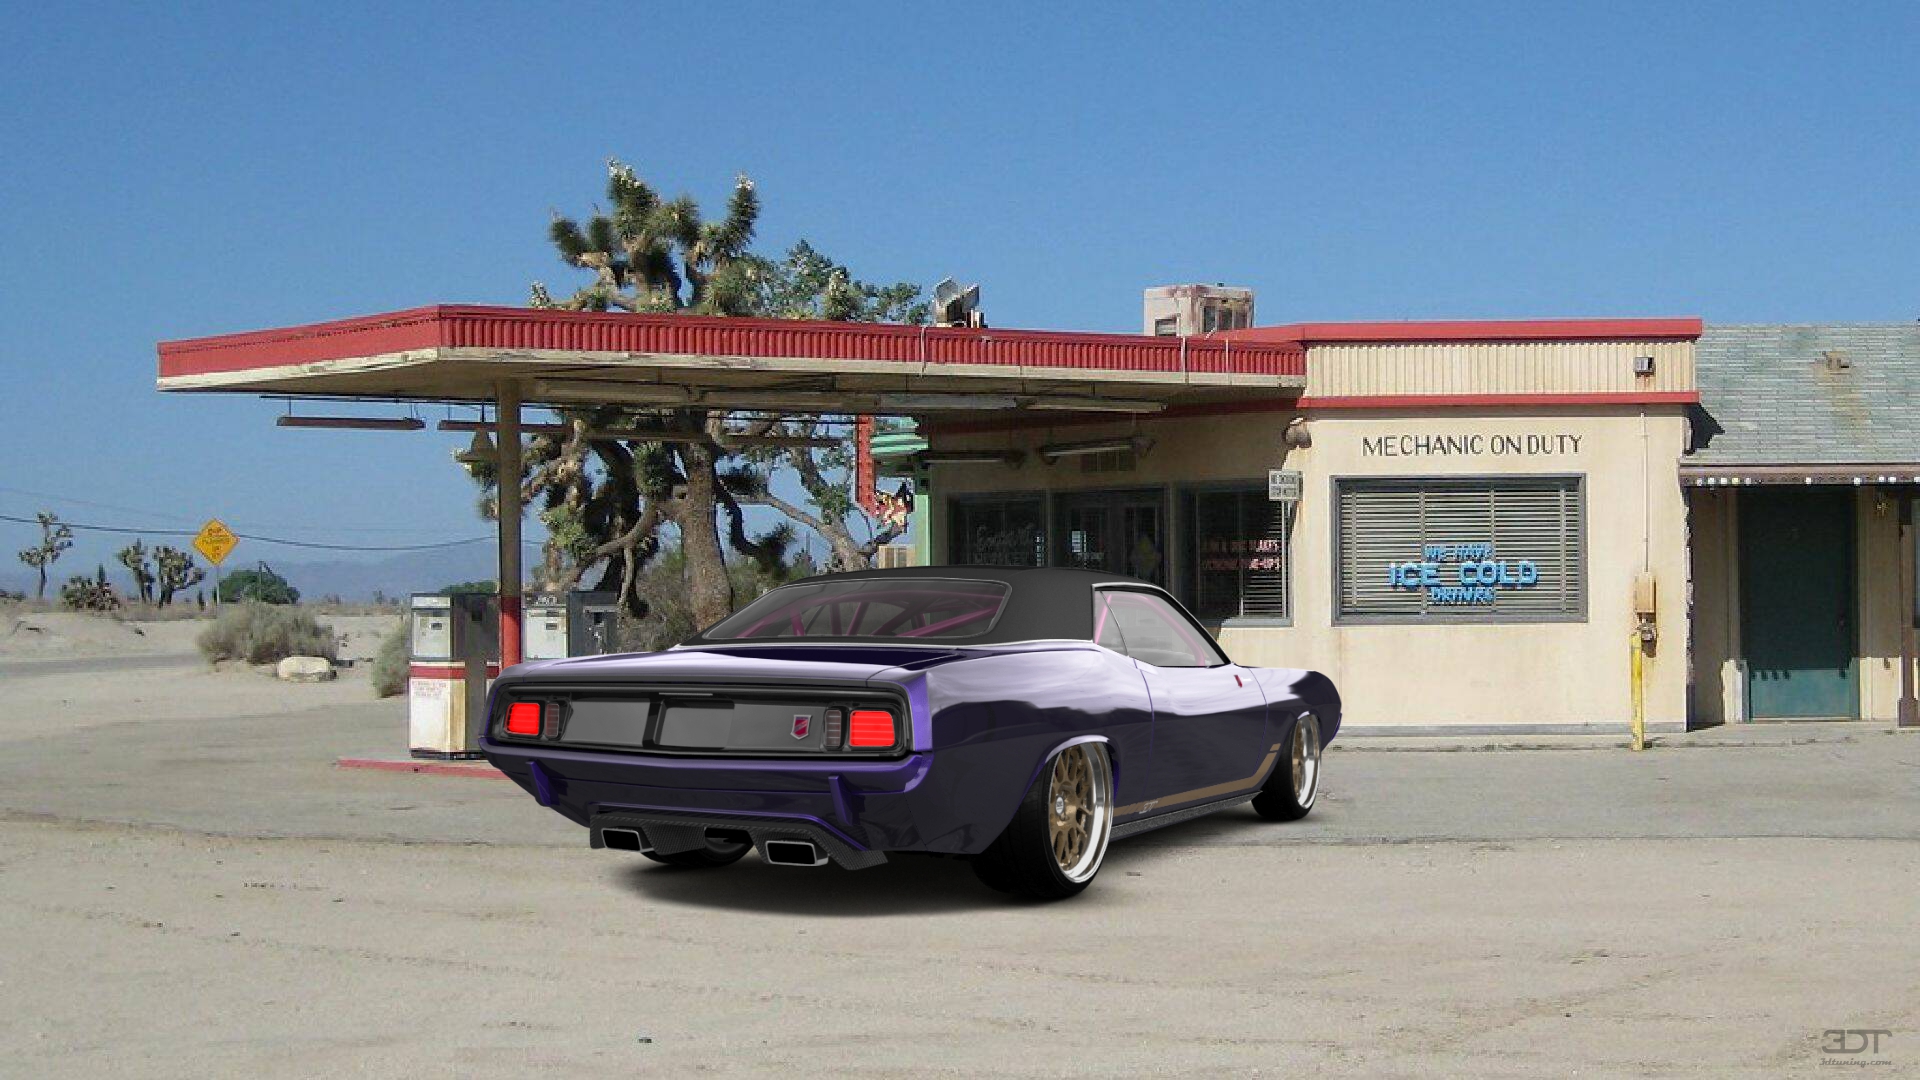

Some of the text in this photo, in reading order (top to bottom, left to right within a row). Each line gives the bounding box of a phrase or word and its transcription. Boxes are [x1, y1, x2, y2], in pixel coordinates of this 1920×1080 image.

[1362, 434, 1583, 457] MECHANIC ON DUTY
[1388, 560, 1538, 587] ICE COLD
